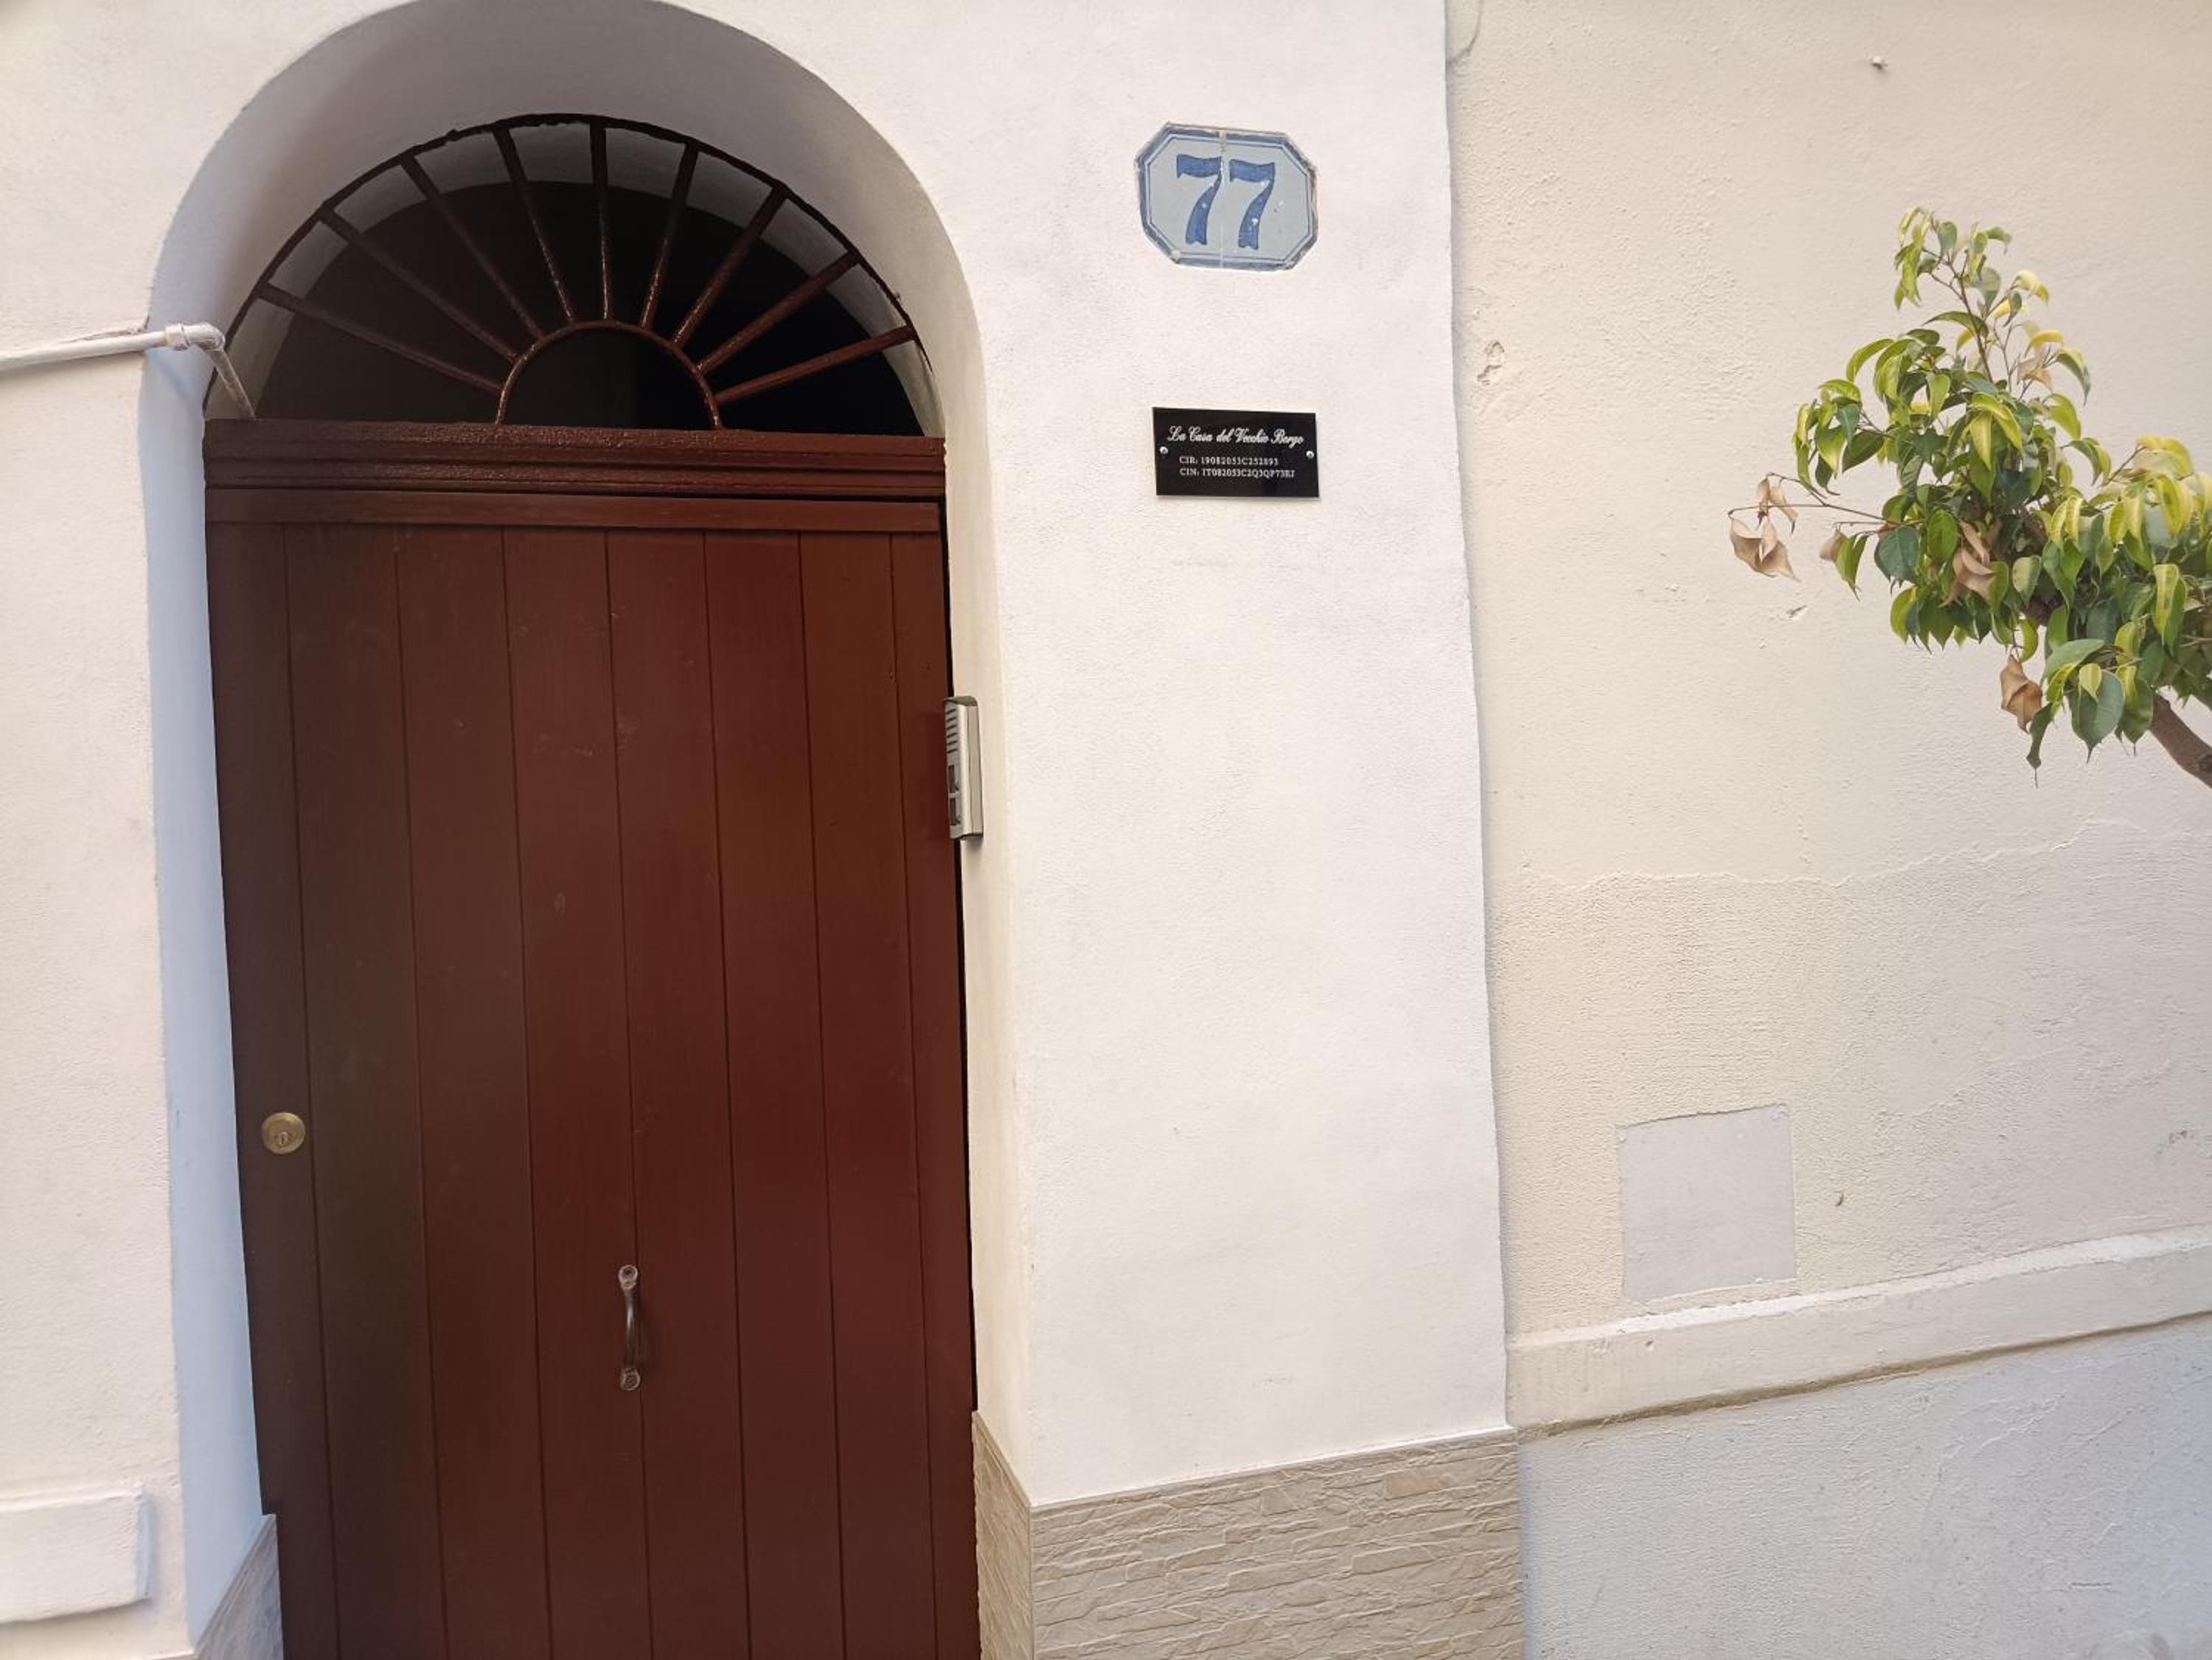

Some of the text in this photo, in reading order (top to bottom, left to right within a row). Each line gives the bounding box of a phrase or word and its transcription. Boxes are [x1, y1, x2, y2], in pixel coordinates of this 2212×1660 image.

[1177, 153, 1275, 250] 77
[1167, 426, 1304, 448] La Casa del Vecchio Borgo
[1180, 456, 1198, 464] CIR:
[1180, 468, 1200, 476] CIN:
